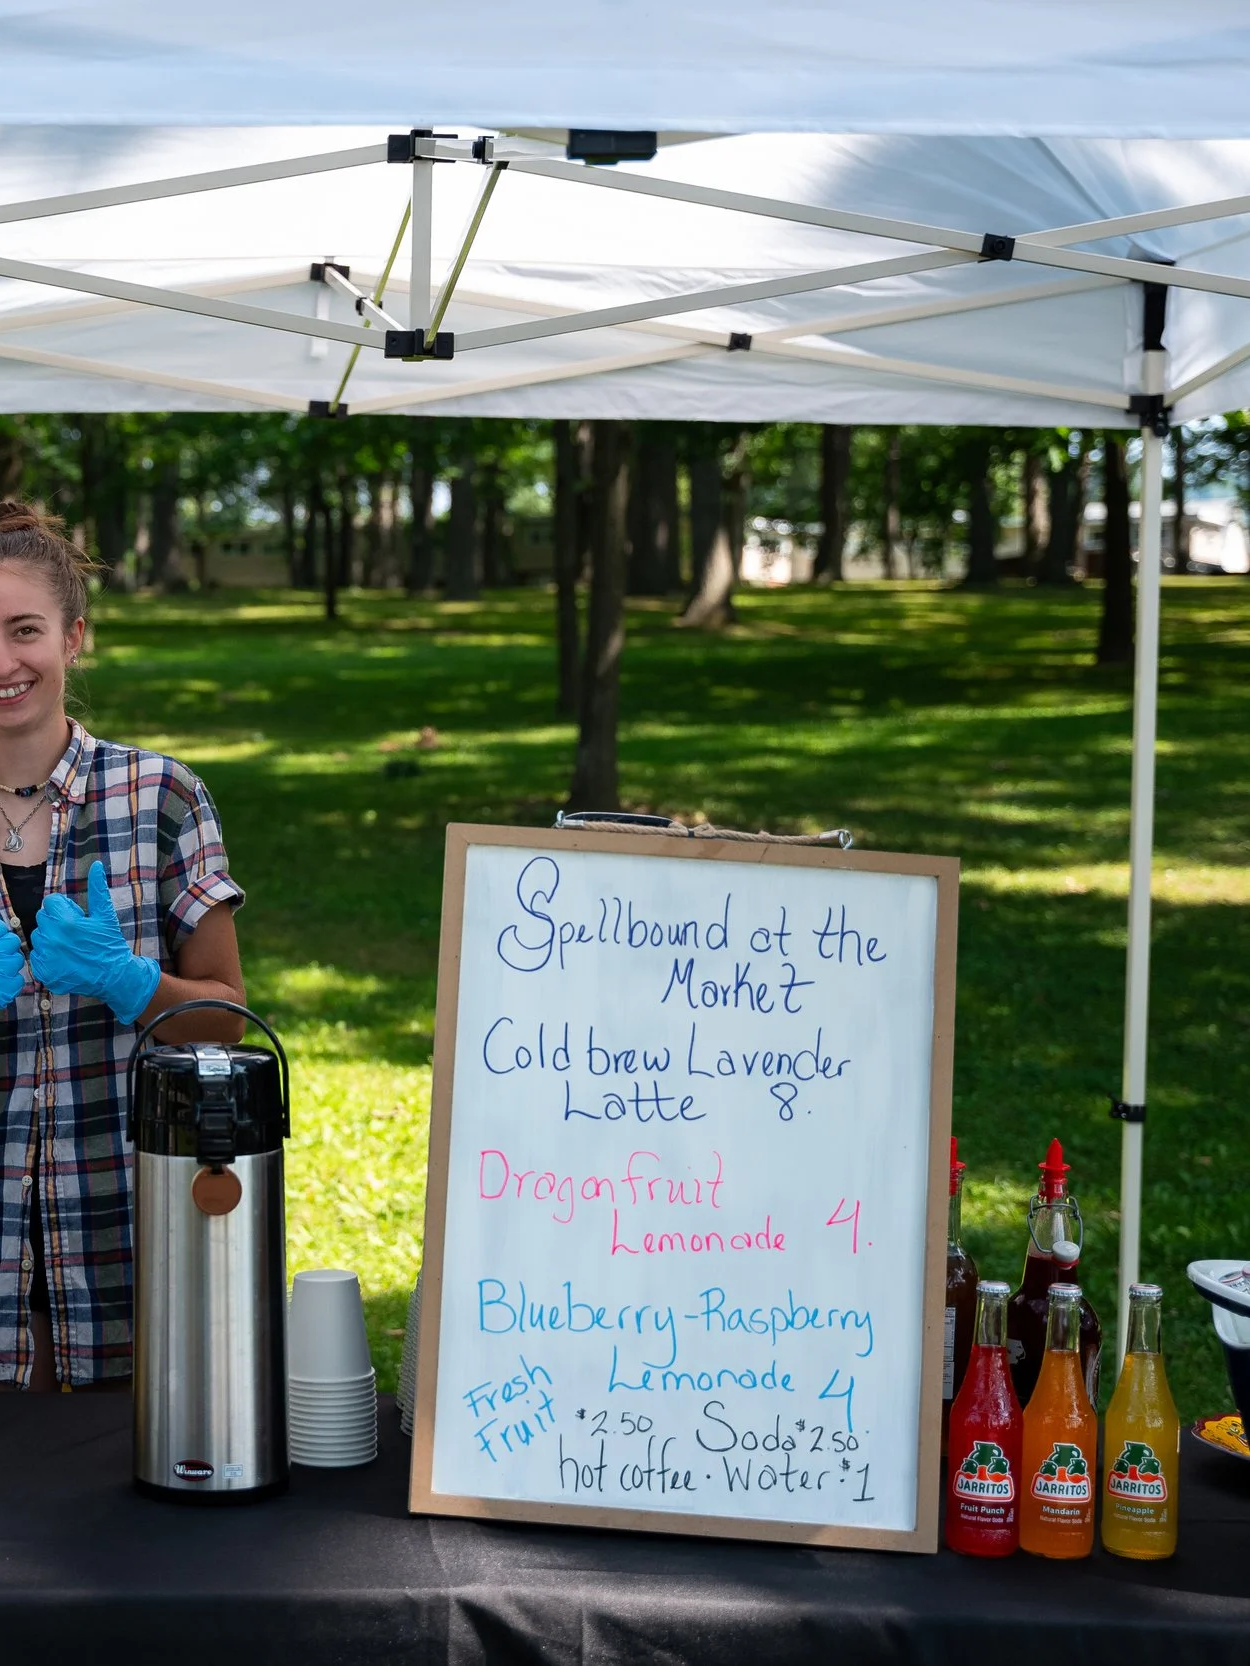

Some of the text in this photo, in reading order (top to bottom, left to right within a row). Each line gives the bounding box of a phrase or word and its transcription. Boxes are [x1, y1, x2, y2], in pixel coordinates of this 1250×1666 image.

[497, 856, 887, 972] Spellbound at the
[661, 957, 816, 1014] Market
[483, 1017, 851, 1080] Cold brew Lavender
[564, 1080, 707, 1122] Latte
[611, 1209, 786, 1255] Lemonade
[478, 1279, 873, 1369] Blueberry-Raspberry
[463, 1354, 553, 1418] Fresh
[608, 1345, 795, 1393] Lemonade
[474, 1389, 653, 1463] Fruit $2.50
[696, 1400, 796, 1453] Soda
[174, 1464, 213, 1475] Winware
[559, 1433, 608, 1493] hot
[620, 1435, 698, 1494] coffee
[958, 1479, 1009, 1495] JARRITOS
[1110, 1479, 1161, 1495] JARRITOS
[960, 1503, 979, 1513] Fruit
[981, 1506, 1005, 1515] Punch
[1036, 1481, 1087, 1496] JARRITOS
[1042, 1505, 1081, 1516] Mandarin
[1116, 1503, 1155, 1515] Pineapple
